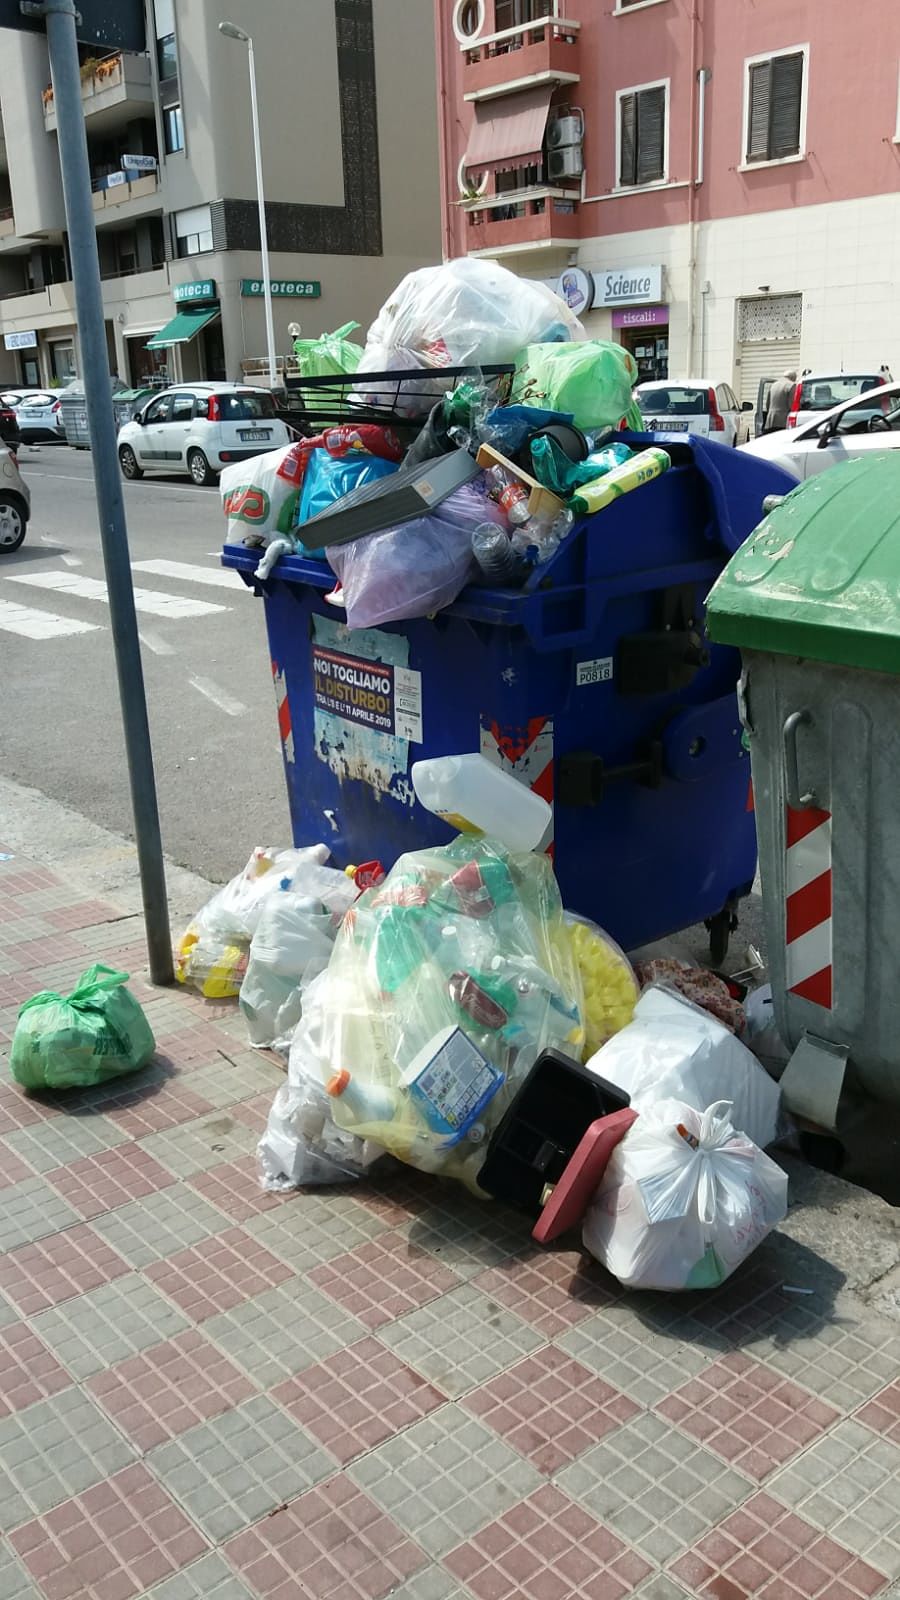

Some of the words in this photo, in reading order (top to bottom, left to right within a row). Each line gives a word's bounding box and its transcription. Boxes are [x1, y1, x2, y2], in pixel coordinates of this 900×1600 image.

[605, 275, 651, 297] Science
[313, 658, 331, 677] NOI
[333, 664, 391, 695] TOGLIAMO
[315, 675, 325, 693] IL
[326, 679, 391, 714] DISTURBO!
[316, 693, 327, 704] TRA
[336, 700, 340, 710] E
[352, 708, 374, 722] APRILE
[375, 715, 391, 728] 2019
